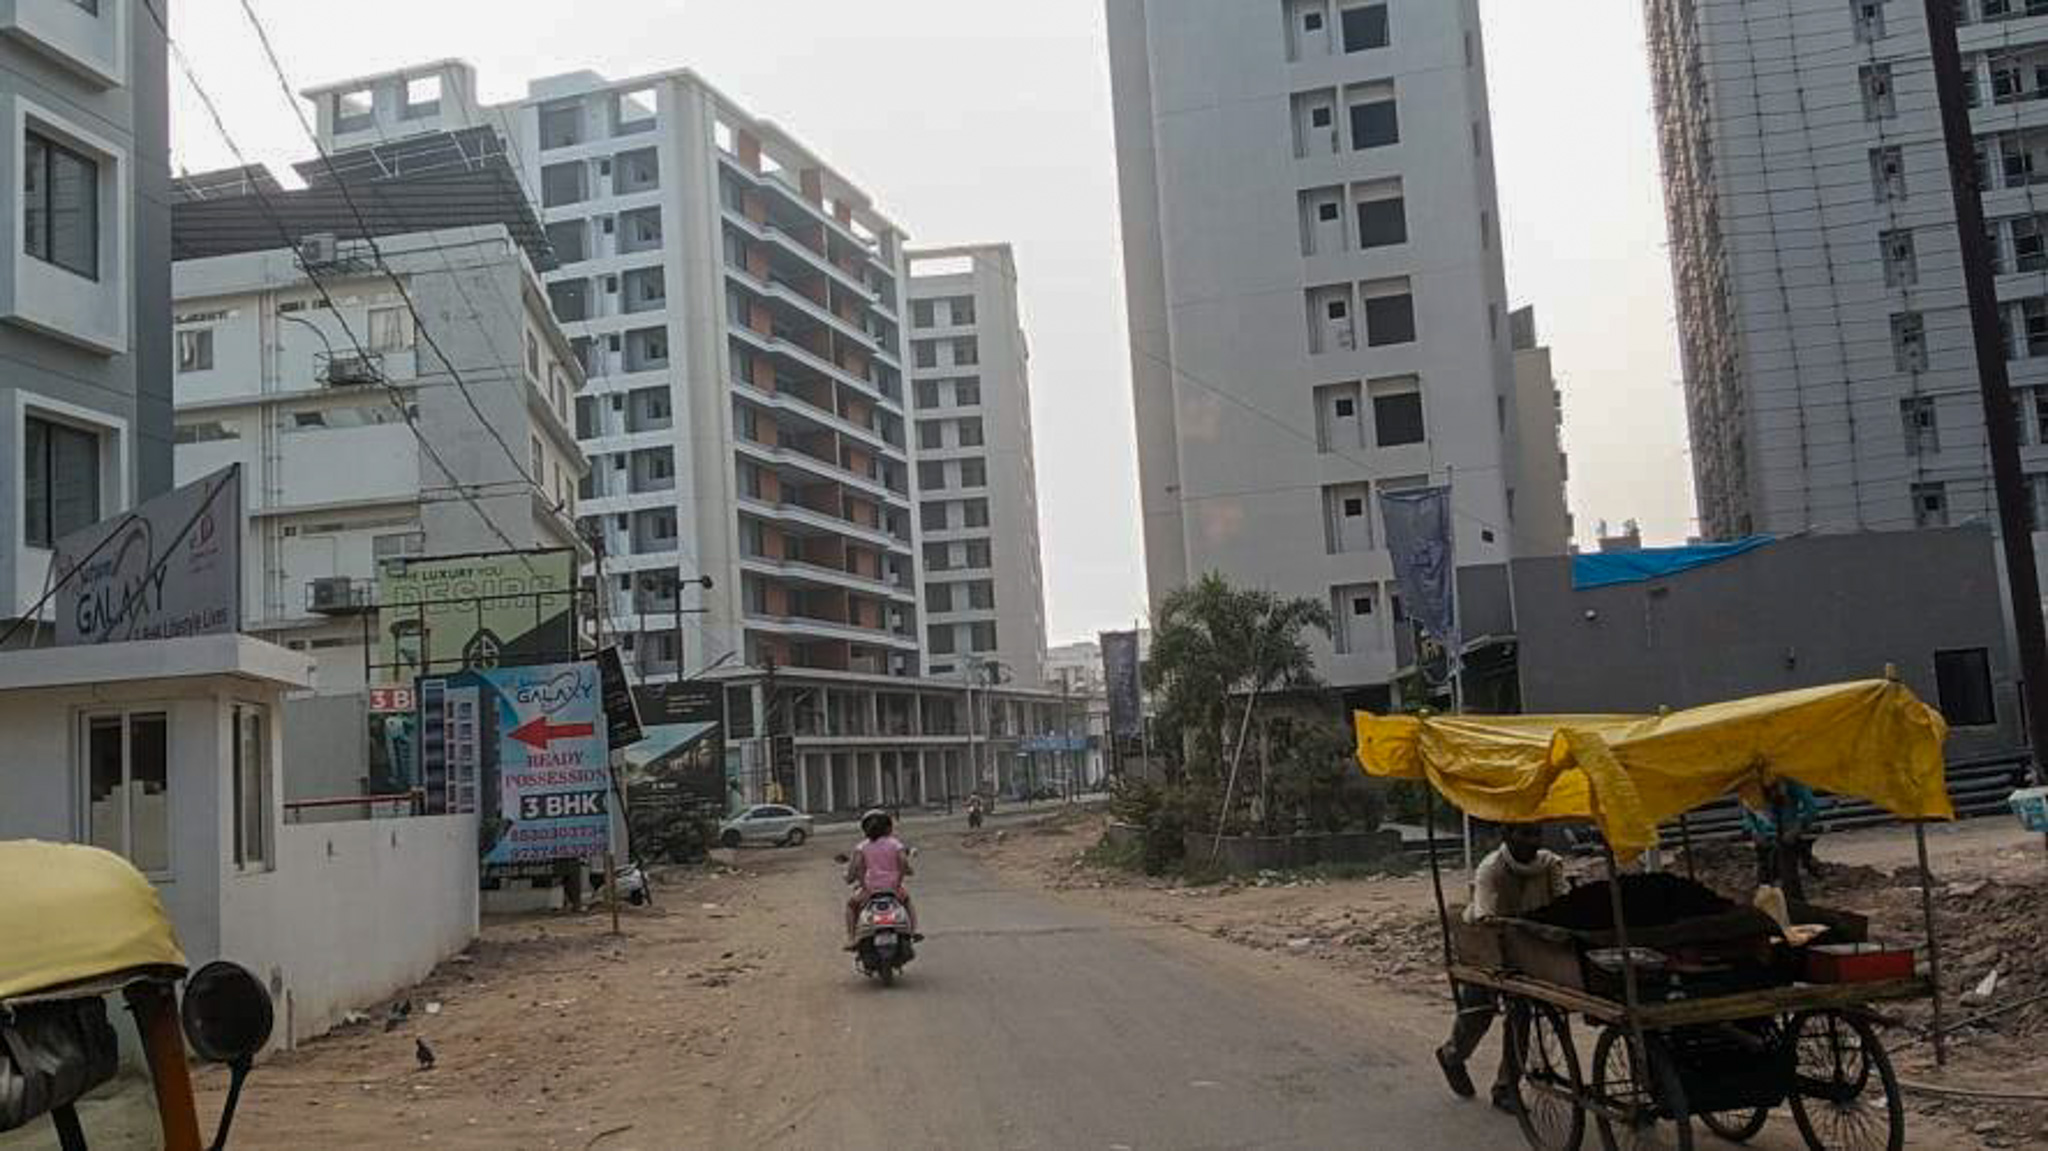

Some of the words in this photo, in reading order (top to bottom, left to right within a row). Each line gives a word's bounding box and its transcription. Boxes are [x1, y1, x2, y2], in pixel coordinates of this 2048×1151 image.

[422, 567, 473, 581] LUXURY
[76, 564, 168, 634] GALAXY
[371, 691, 387, 709] 3
[517, 682, 593, 703] GALAXY
[527, 749, 584, 768] READY
[506, 769, 608, 788] POSSESSION
[524, 796, 540, 819] 3
[546, 793, 598, 817] BHK
